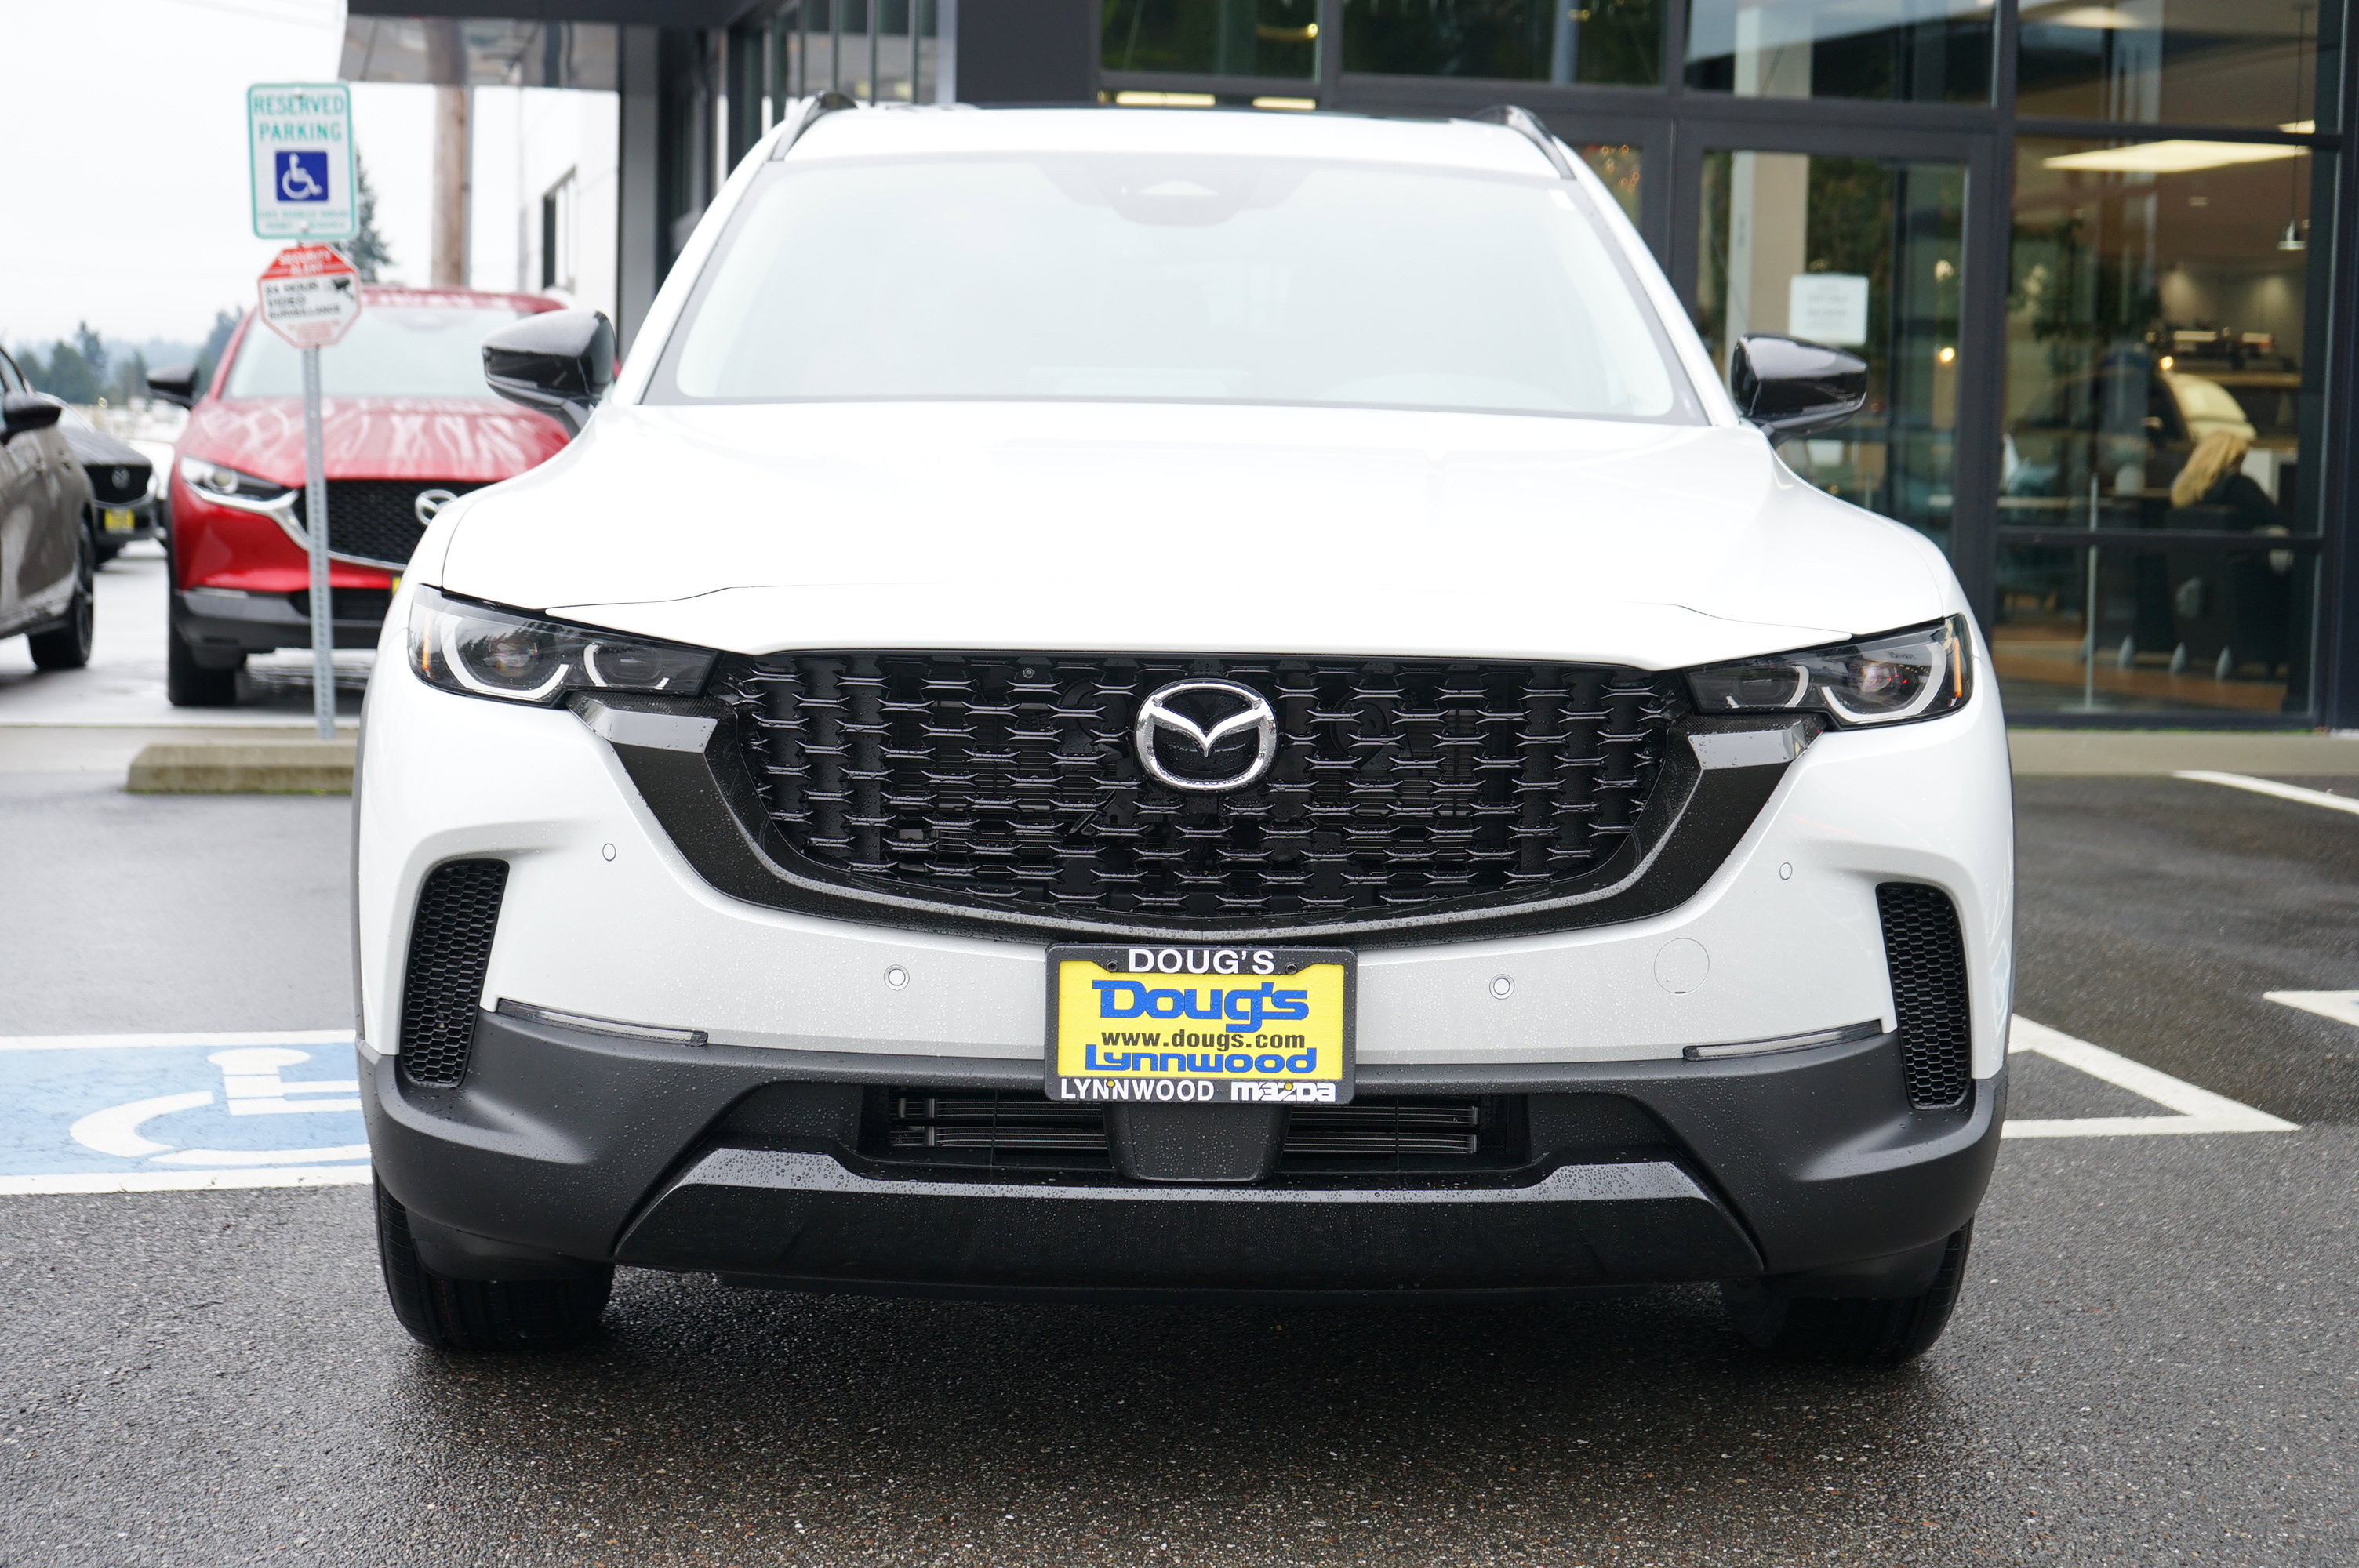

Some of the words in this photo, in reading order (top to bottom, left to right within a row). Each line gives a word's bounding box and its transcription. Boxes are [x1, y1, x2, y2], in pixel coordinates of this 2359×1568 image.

[253, 93, 345, 116] RESERVED
[258, 120, 343, 143] PARKING
[1128, 949, 1275, 975] DOUG'S
[1092, 979, 1310, 1033] Doug's
[1100, 1029, 1306, 1051] www.dougs.com
[1085, 1044, 1317, 1073] Lynnwood
[1060, 1077, 1215, 1102] LYNNWOOD
